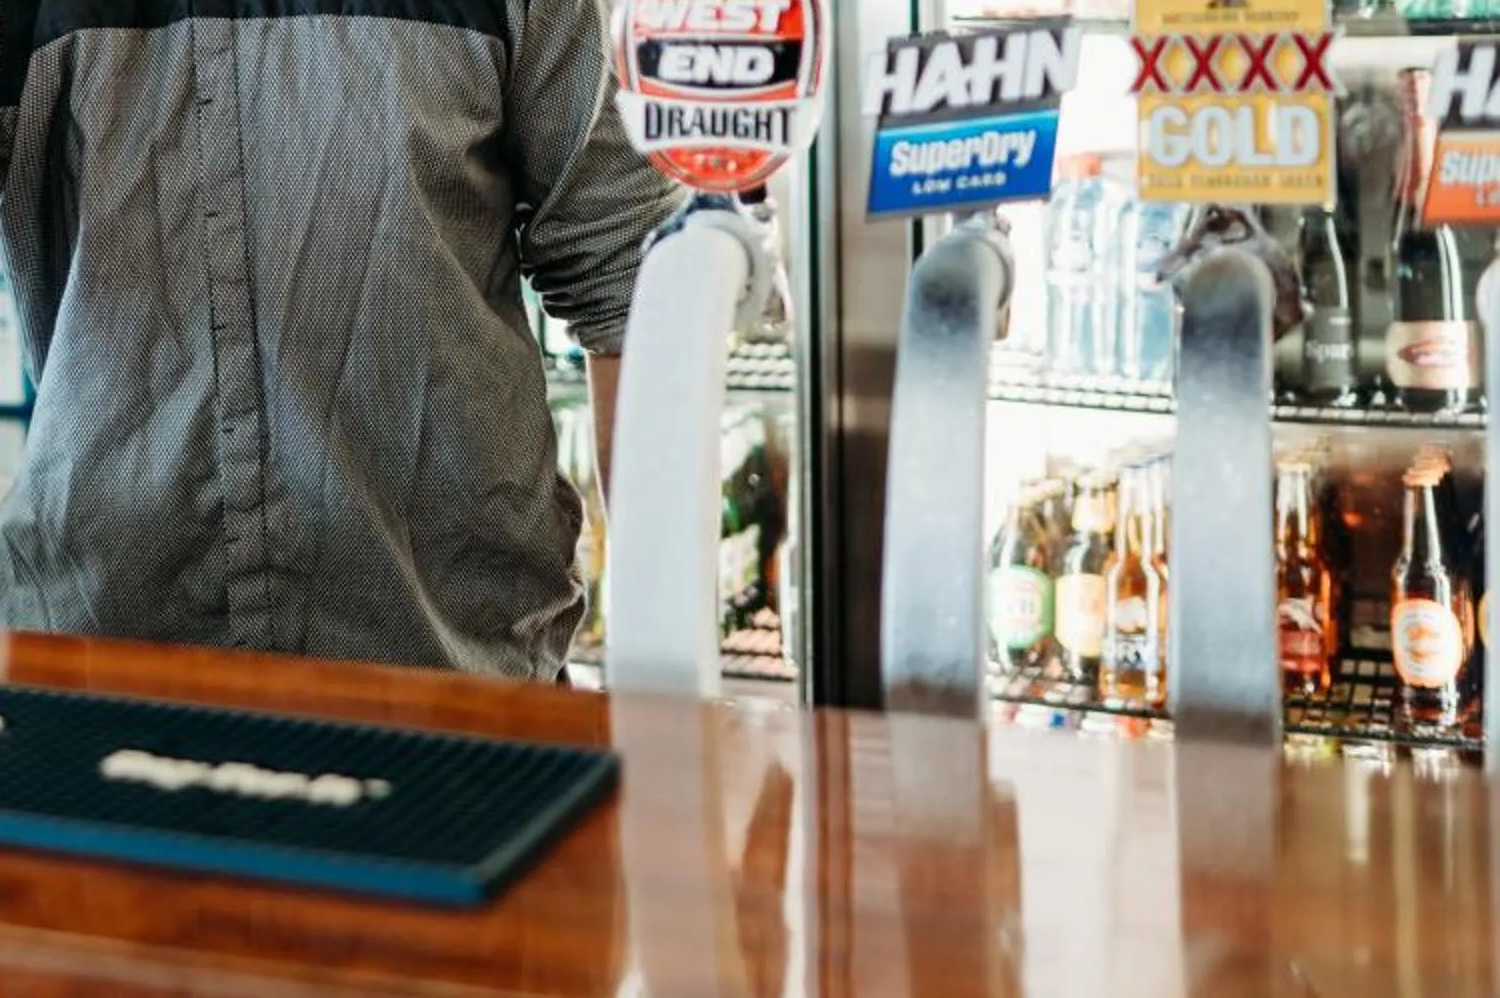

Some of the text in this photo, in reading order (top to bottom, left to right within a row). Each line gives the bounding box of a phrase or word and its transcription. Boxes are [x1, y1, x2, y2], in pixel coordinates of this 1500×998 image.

[657, 45, 776, 85] END
[861, 27, 1082, 116] HAHN
[1127, 32, 1336, 93] XXXX
[644, 102, 798, 145] DRAUGHT
[1149, 105, 1320, 168] GOLD
[889, 129, 1037, 177] SuperDry
